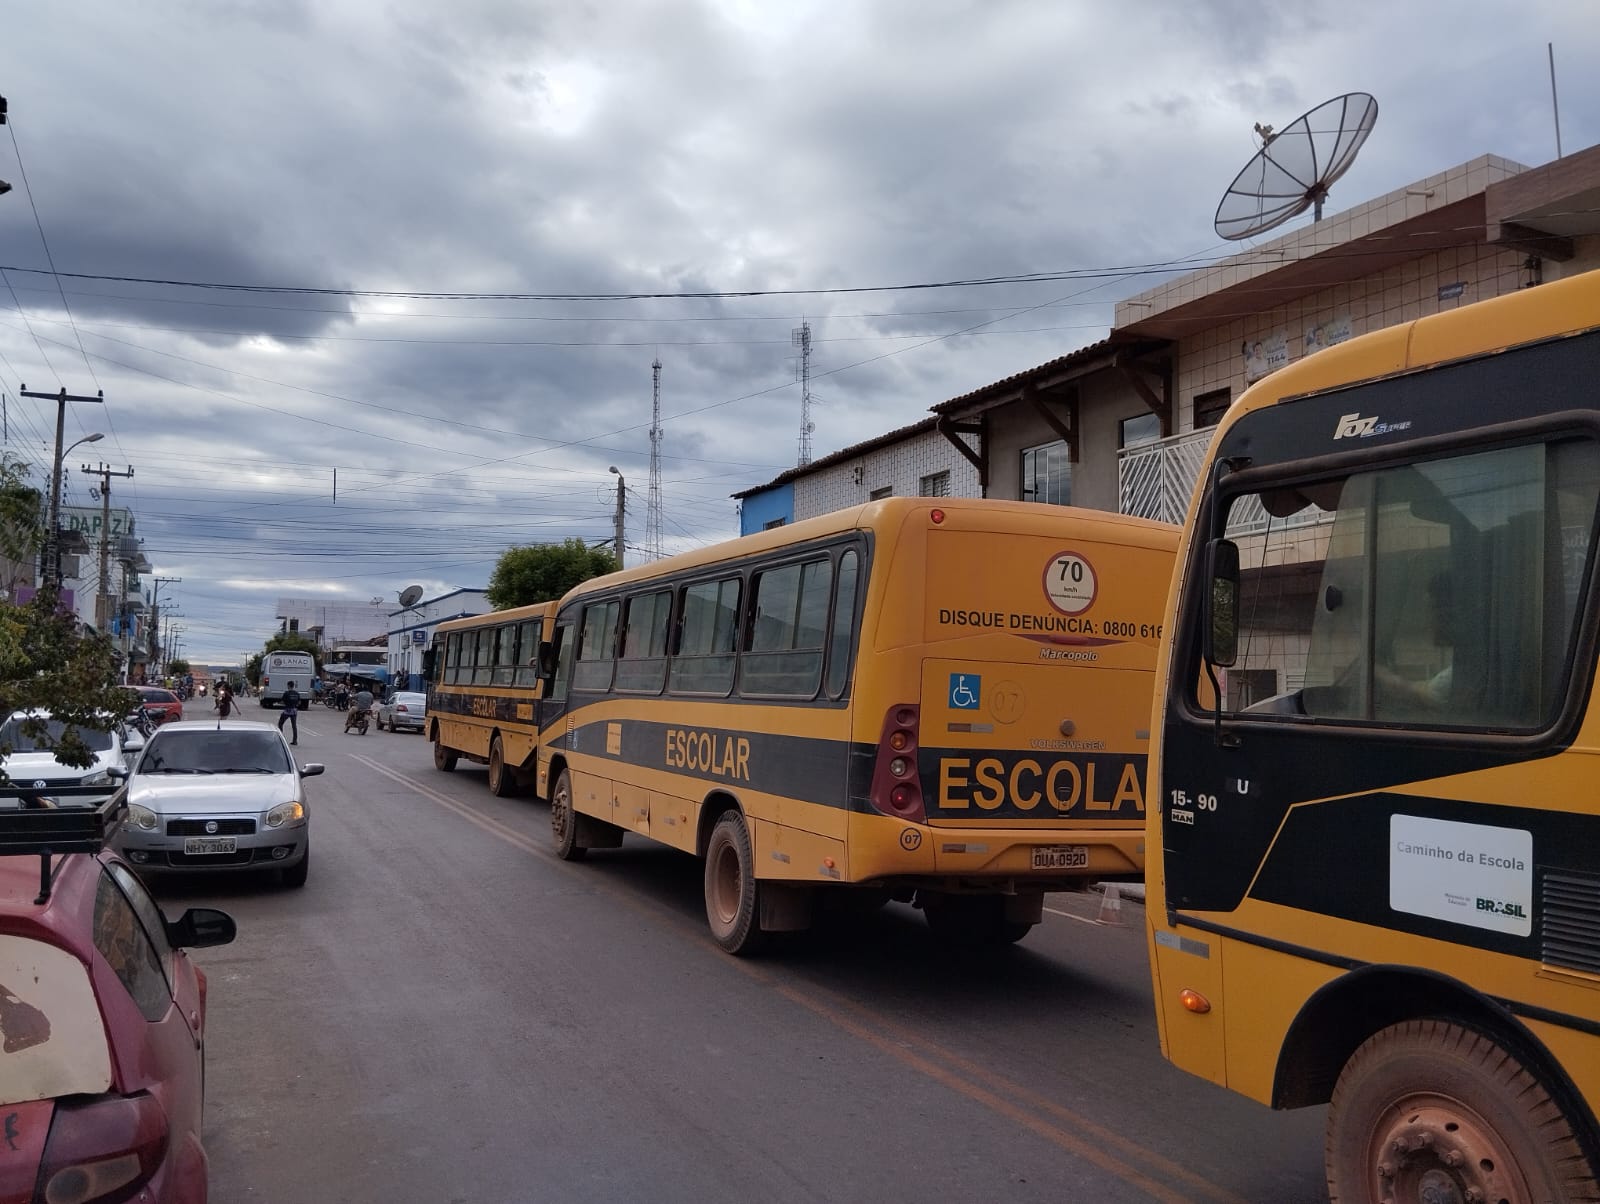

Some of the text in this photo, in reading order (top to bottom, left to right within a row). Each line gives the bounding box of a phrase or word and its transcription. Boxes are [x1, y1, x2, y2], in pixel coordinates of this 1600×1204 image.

[93, 516, 122, 535] PZ
[1058, 560, 1083, 582] 70
[939, 609, 1004, 627] DISQUE
[1010, 612, 1098, 634] DENÚNCIA:
[1103, 621, 1136, 637] 0800
[1039, 648, 1098, 661] Marcopolo
[1031, 739, 1105, 749] VOLKSWAGEN
[665, 729, 750, 781] ESCOLAR
[1237, 778, 1249, 794] U
[1172, 813, 1193, 823] MAN
[904, 834, 921, 845] 07
[1397, 841, 1524, 871] Caminho da Escola
[1476, 897, 1527, 918] BRASIL
